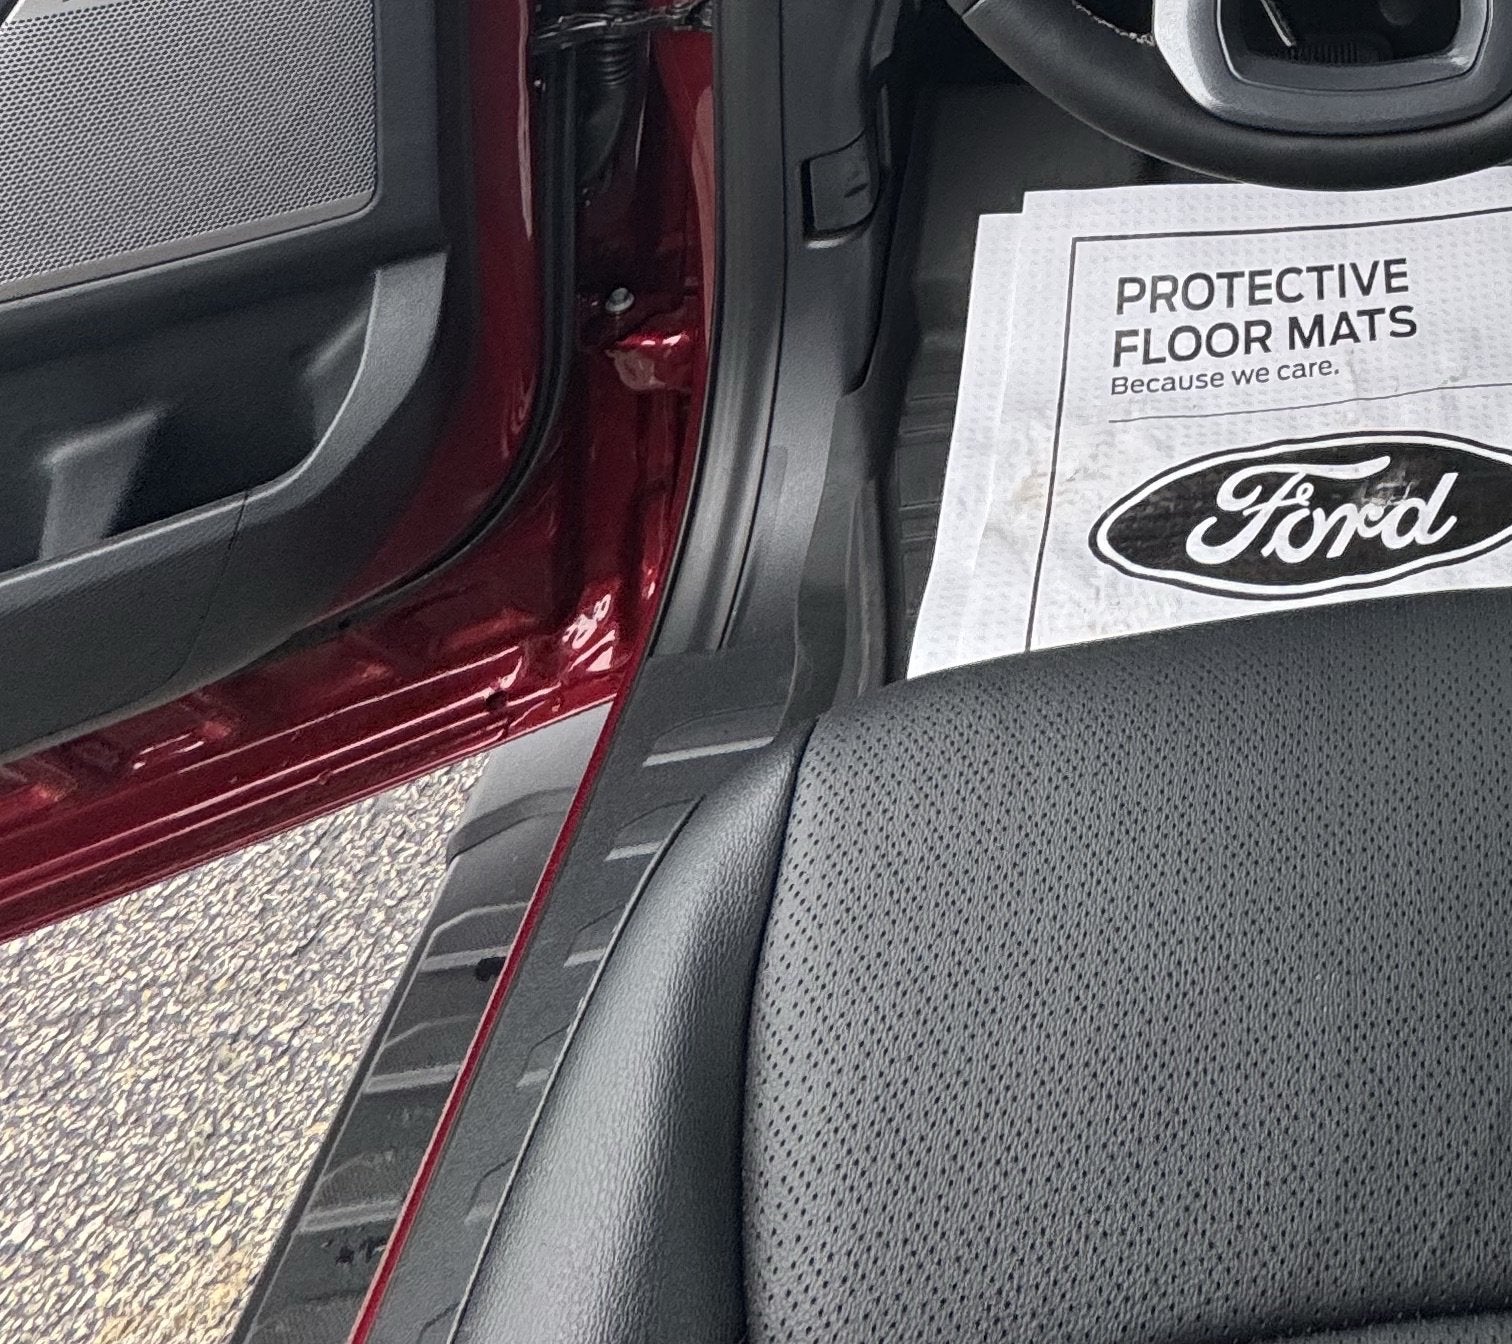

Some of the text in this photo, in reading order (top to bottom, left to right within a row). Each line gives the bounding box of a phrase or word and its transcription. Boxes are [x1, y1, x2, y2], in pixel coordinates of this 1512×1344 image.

[1115, 257, 1411, 316] PROTECTIVE
[1112, 304, 1418, 369] FLOOR MATS
[1110, 357, 1342, 397] Because we care.
[1185, 454, 1459, 566] Ford
